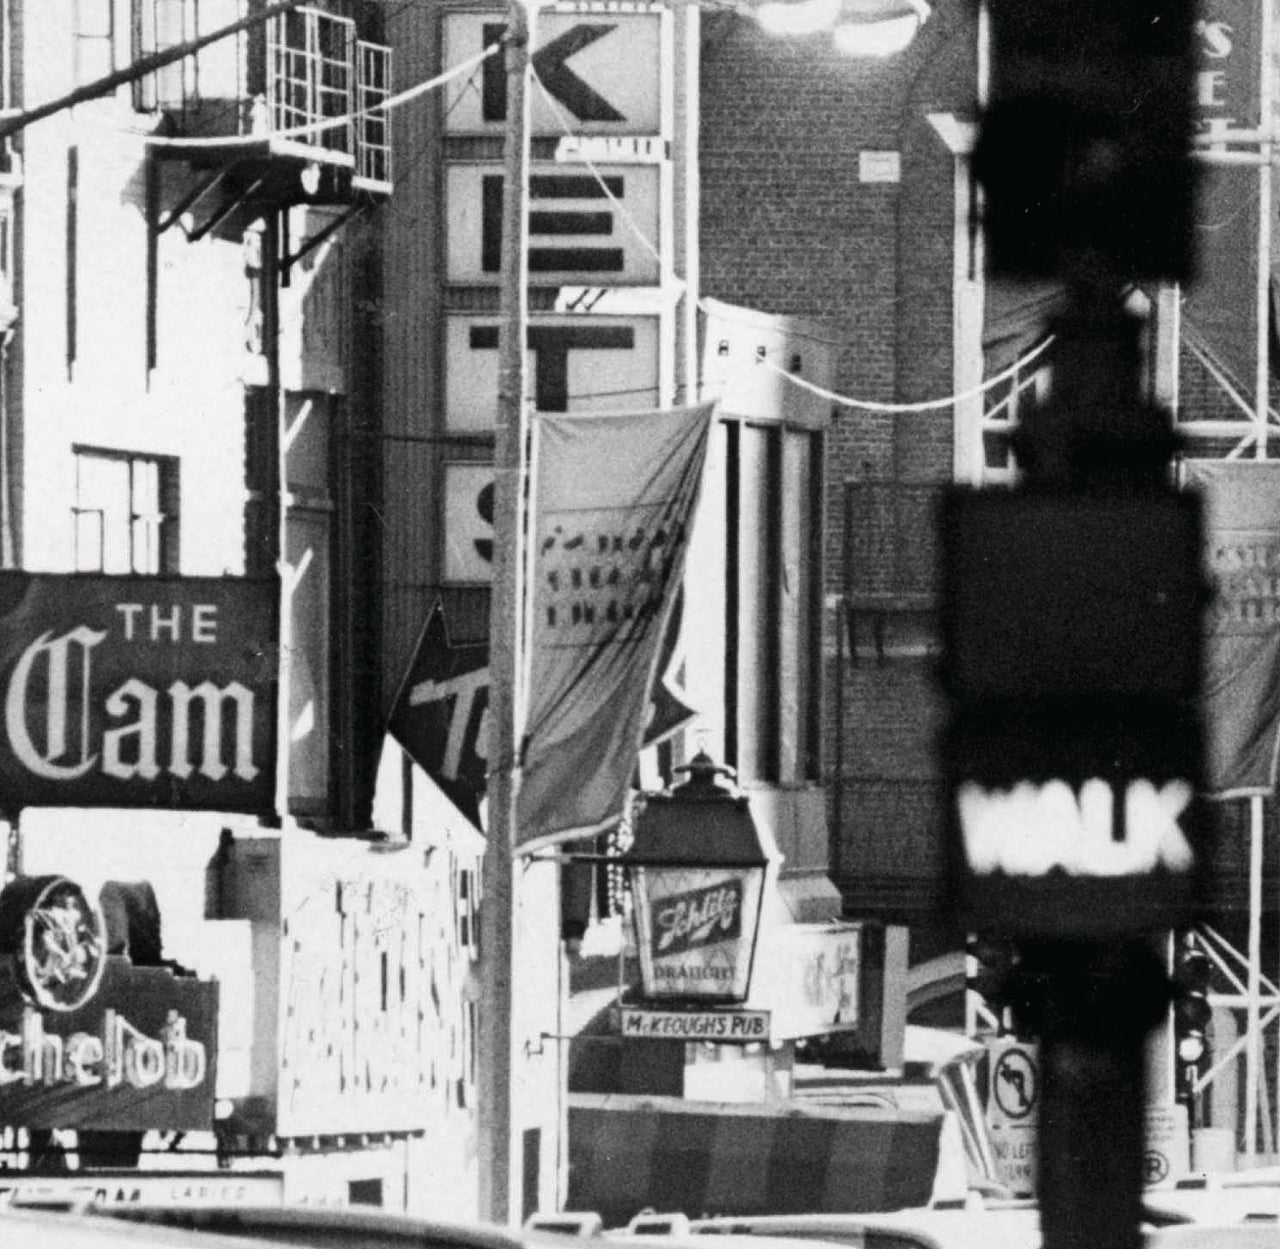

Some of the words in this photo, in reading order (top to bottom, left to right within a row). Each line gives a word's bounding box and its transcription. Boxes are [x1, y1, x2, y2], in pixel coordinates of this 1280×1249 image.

[470, 22, 634, 564] KET
[116, 603, 218, 643] THE
[730, 1014, 765, 1035] PUB
